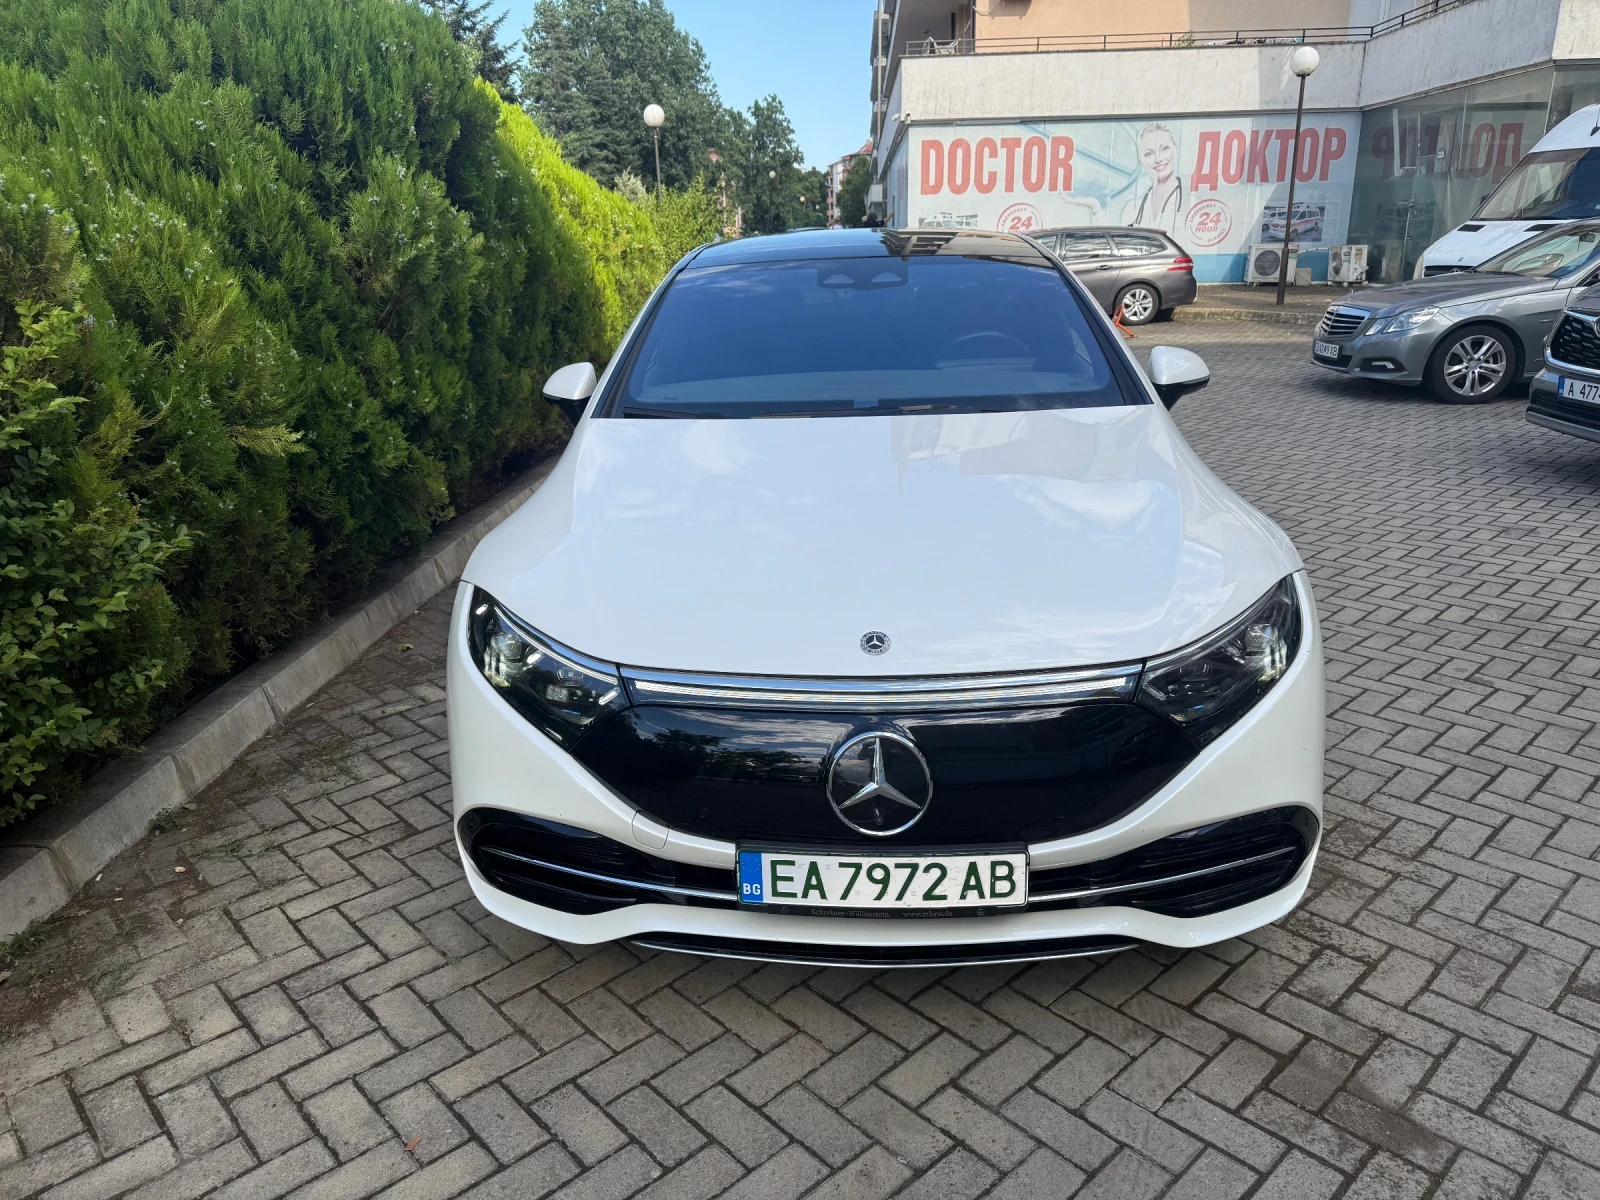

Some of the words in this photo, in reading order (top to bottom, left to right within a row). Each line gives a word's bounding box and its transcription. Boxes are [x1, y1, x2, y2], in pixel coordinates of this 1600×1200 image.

[920, 135, 1075, 196] DOCTOR
[1190, 127, 1347, 192] ДОКТОР
[1008, 215, 1033, 231] 24
[1197, 212, 1221, 226] 24
[1567, 381, 1574, 397] A
[1580, 383, 1600, 401] 477
[742, 882, 761, 896] BG
[770, 859, 828, 900] EA
[838, 861, 948, 901] 7972
[959, 860, 1016, 900] AB
